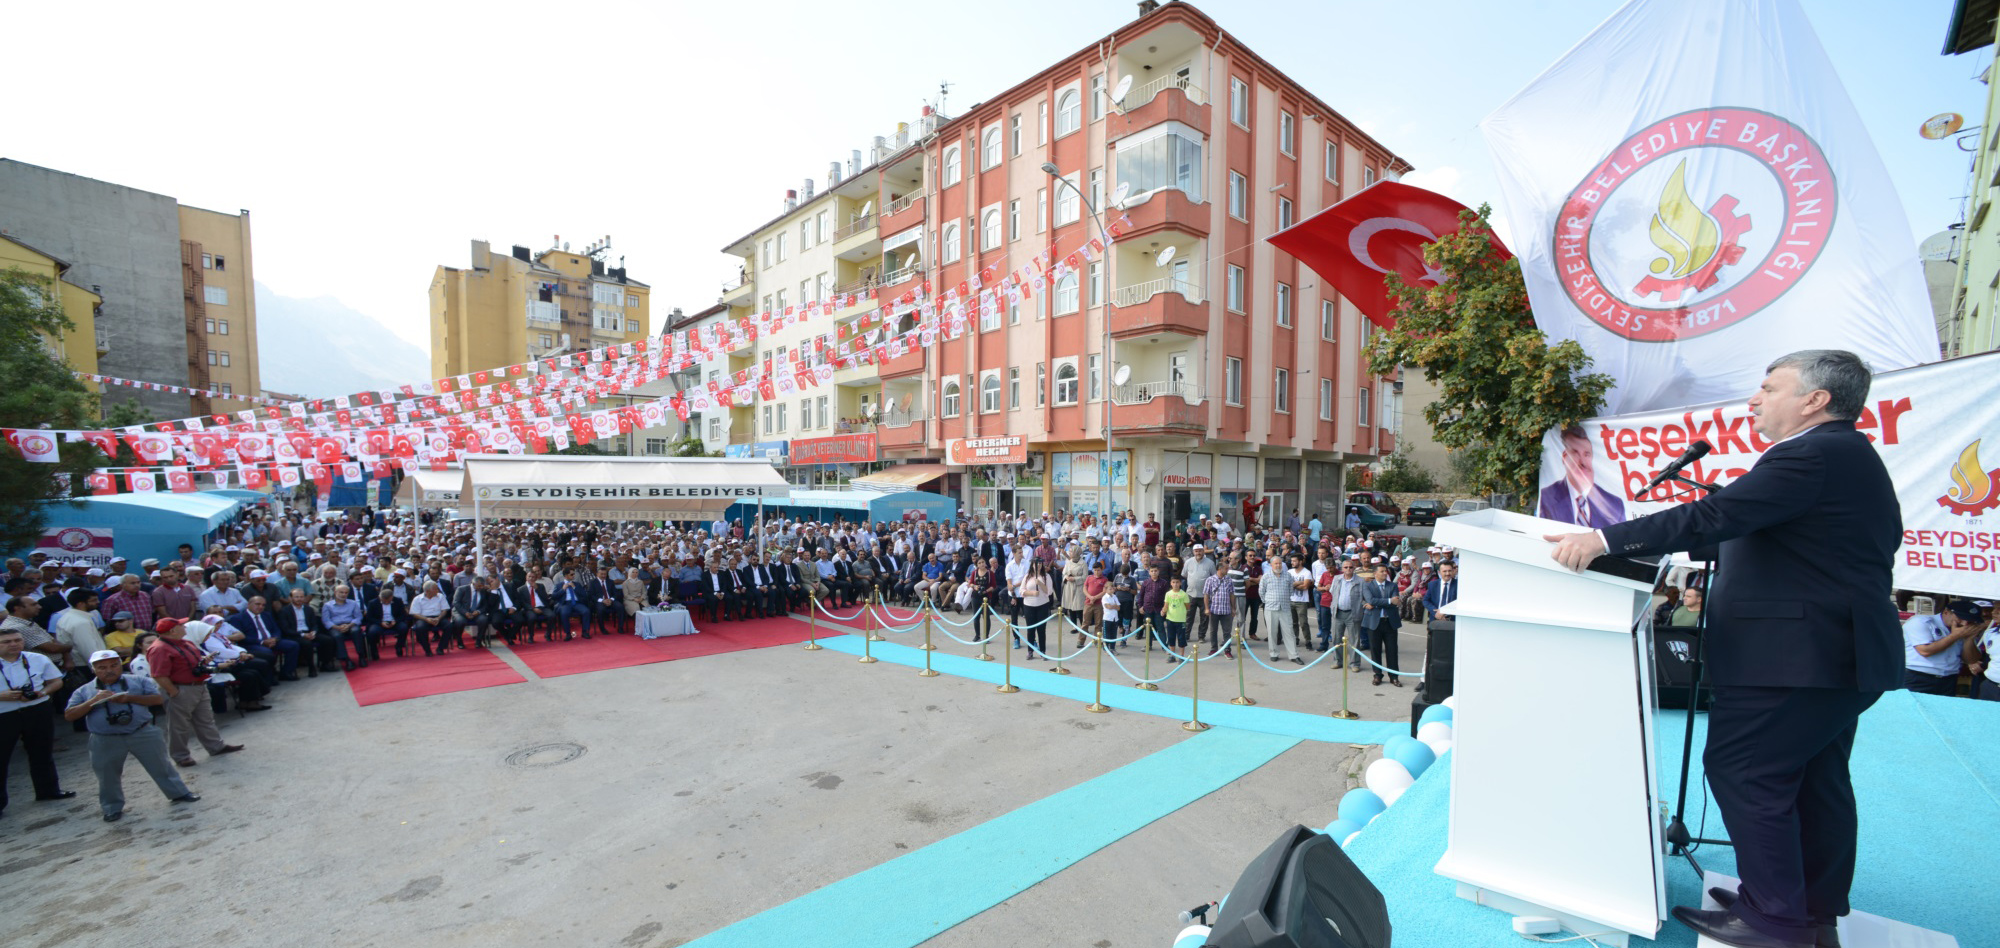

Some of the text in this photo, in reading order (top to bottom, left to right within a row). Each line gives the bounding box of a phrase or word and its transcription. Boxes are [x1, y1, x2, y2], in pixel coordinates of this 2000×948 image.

[1560, 118, 1822, 332] SEYDİŞEHİR BELEDİYE BAŞKANLIĞI
[1686, 299, 1736, 328] 1871
[817, 440, 846, 455] VETERİNER
[966, 437, 1021, 448] VETERİNER
[976, 447, 1009, 456] HEKİM
[1164, 475, 1186, 484] YAVUZ
[501, 486, 641, 499] SEYDİŞEHİR
[649, 486, 763, 497] BELEDİYESİ
[1965, 518, 1983, 526] 1871
